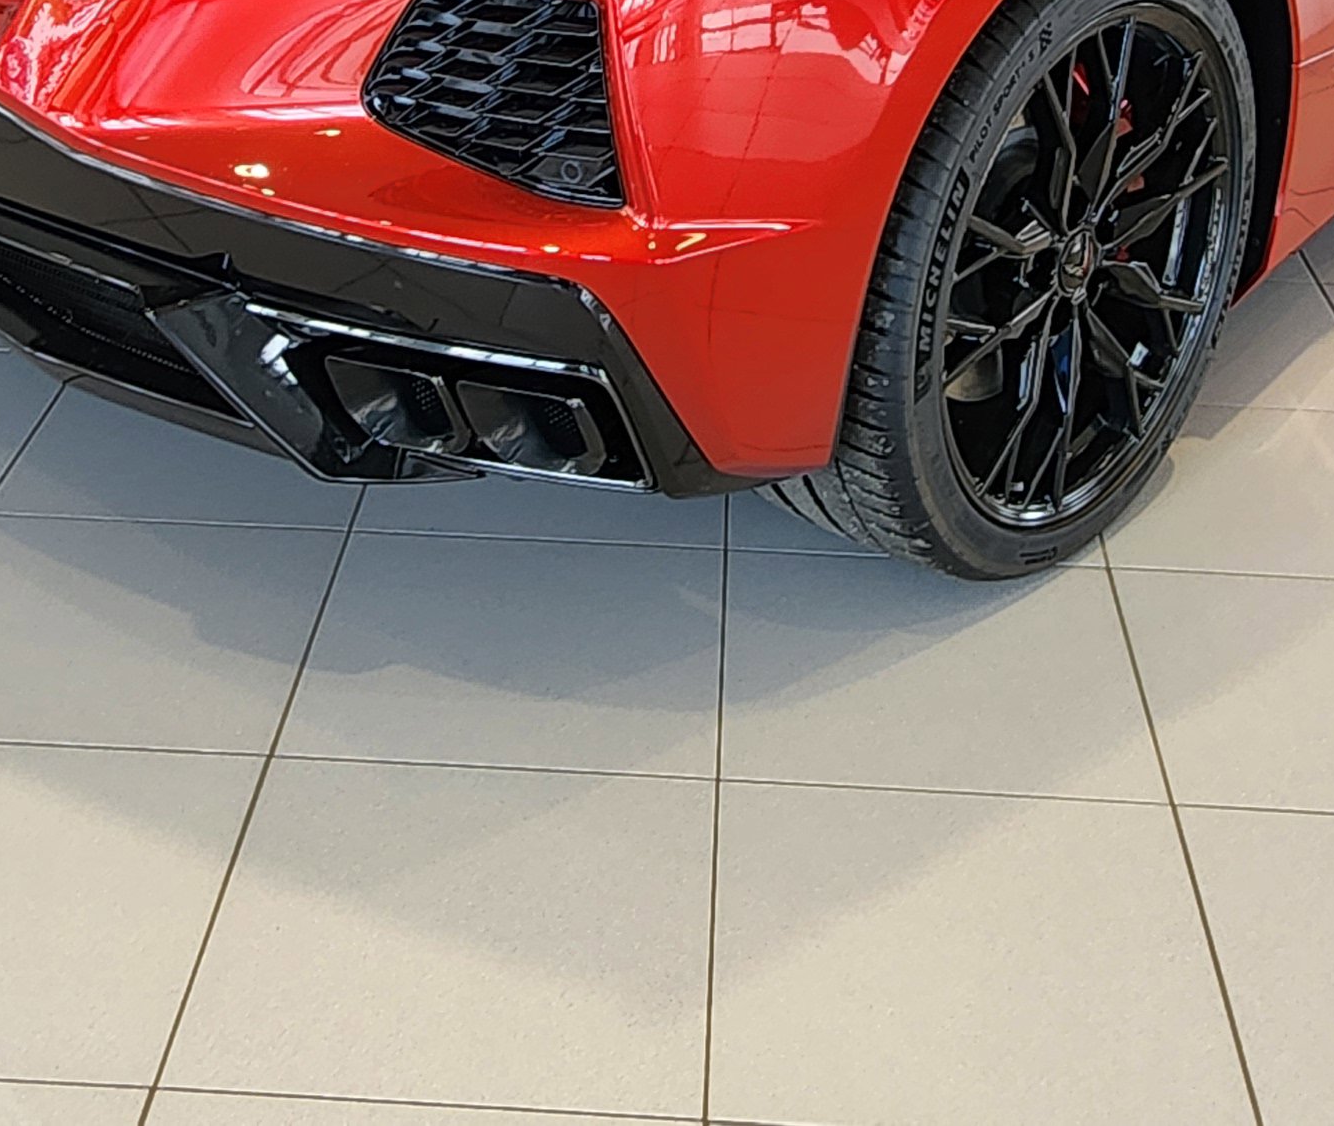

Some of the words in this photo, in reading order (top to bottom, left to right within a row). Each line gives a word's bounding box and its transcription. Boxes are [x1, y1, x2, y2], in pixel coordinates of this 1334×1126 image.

[969, 114, 993, 164] PILOT
[992, 69, 1021, 116] SPORT
[918, 180, 966, 352] MICHELIN
